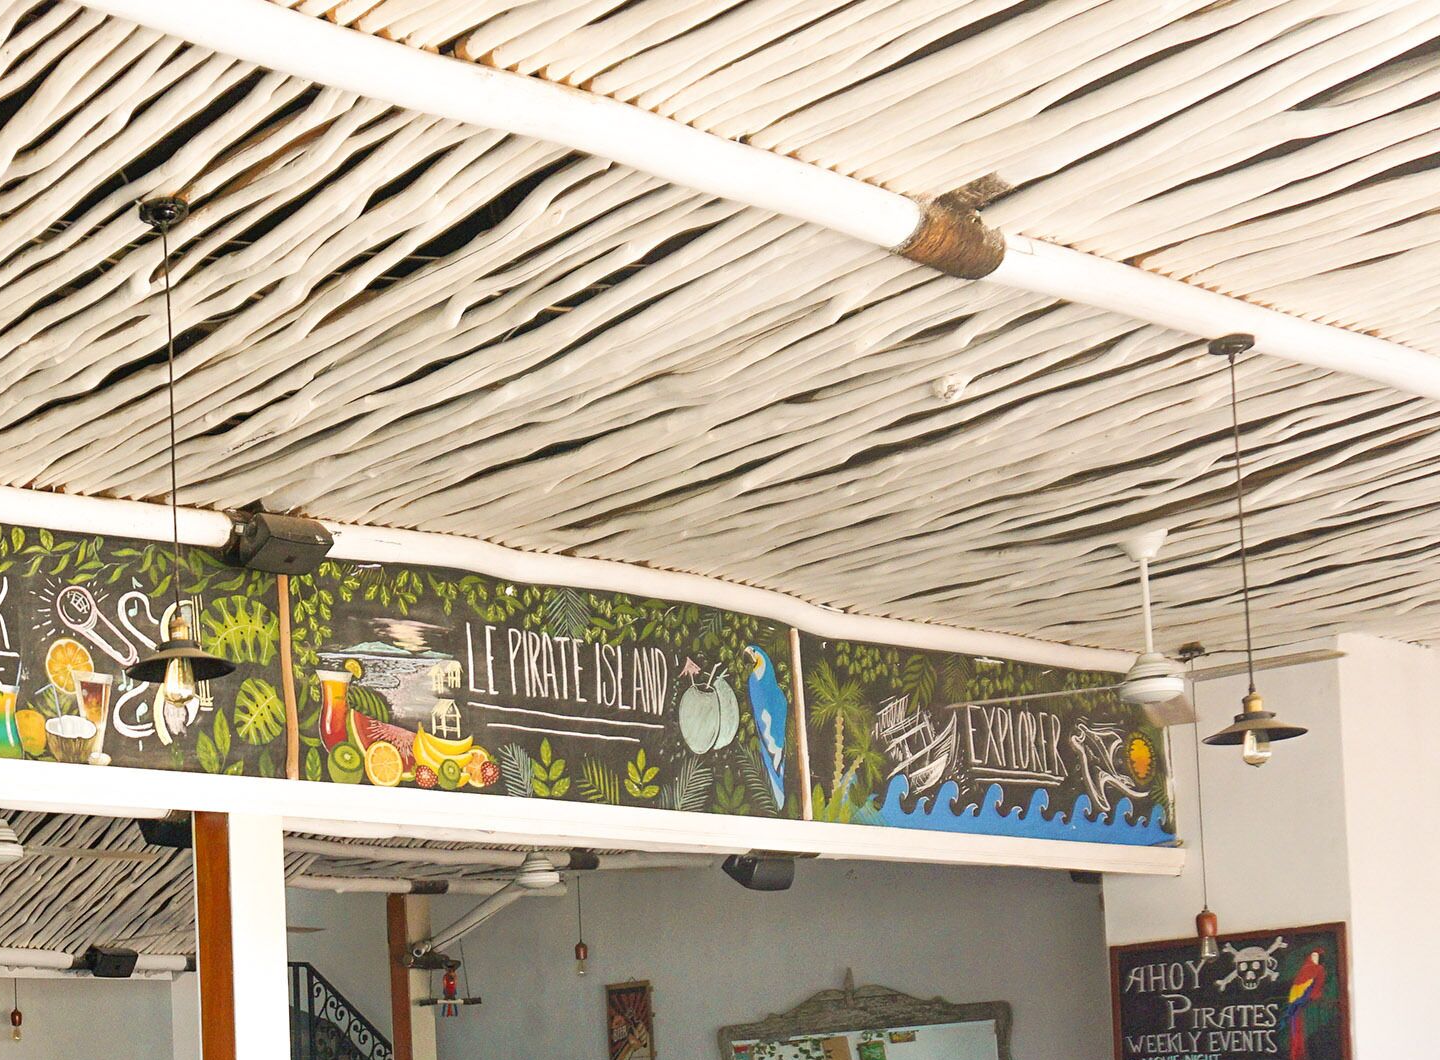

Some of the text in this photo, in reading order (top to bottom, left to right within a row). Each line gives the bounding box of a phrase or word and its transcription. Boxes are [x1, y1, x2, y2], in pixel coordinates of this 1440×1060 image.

[466, 622, 668, 716] LE PIRATE ISLAND
[967, 705, 1069, 776] EXPLORER
[1126, 959, 1207, 992] AHOY
[1160, 994, 1278, 1030] PIRATES
[1126, 1030, 1278, 1053] WEEKLY EVENTS
